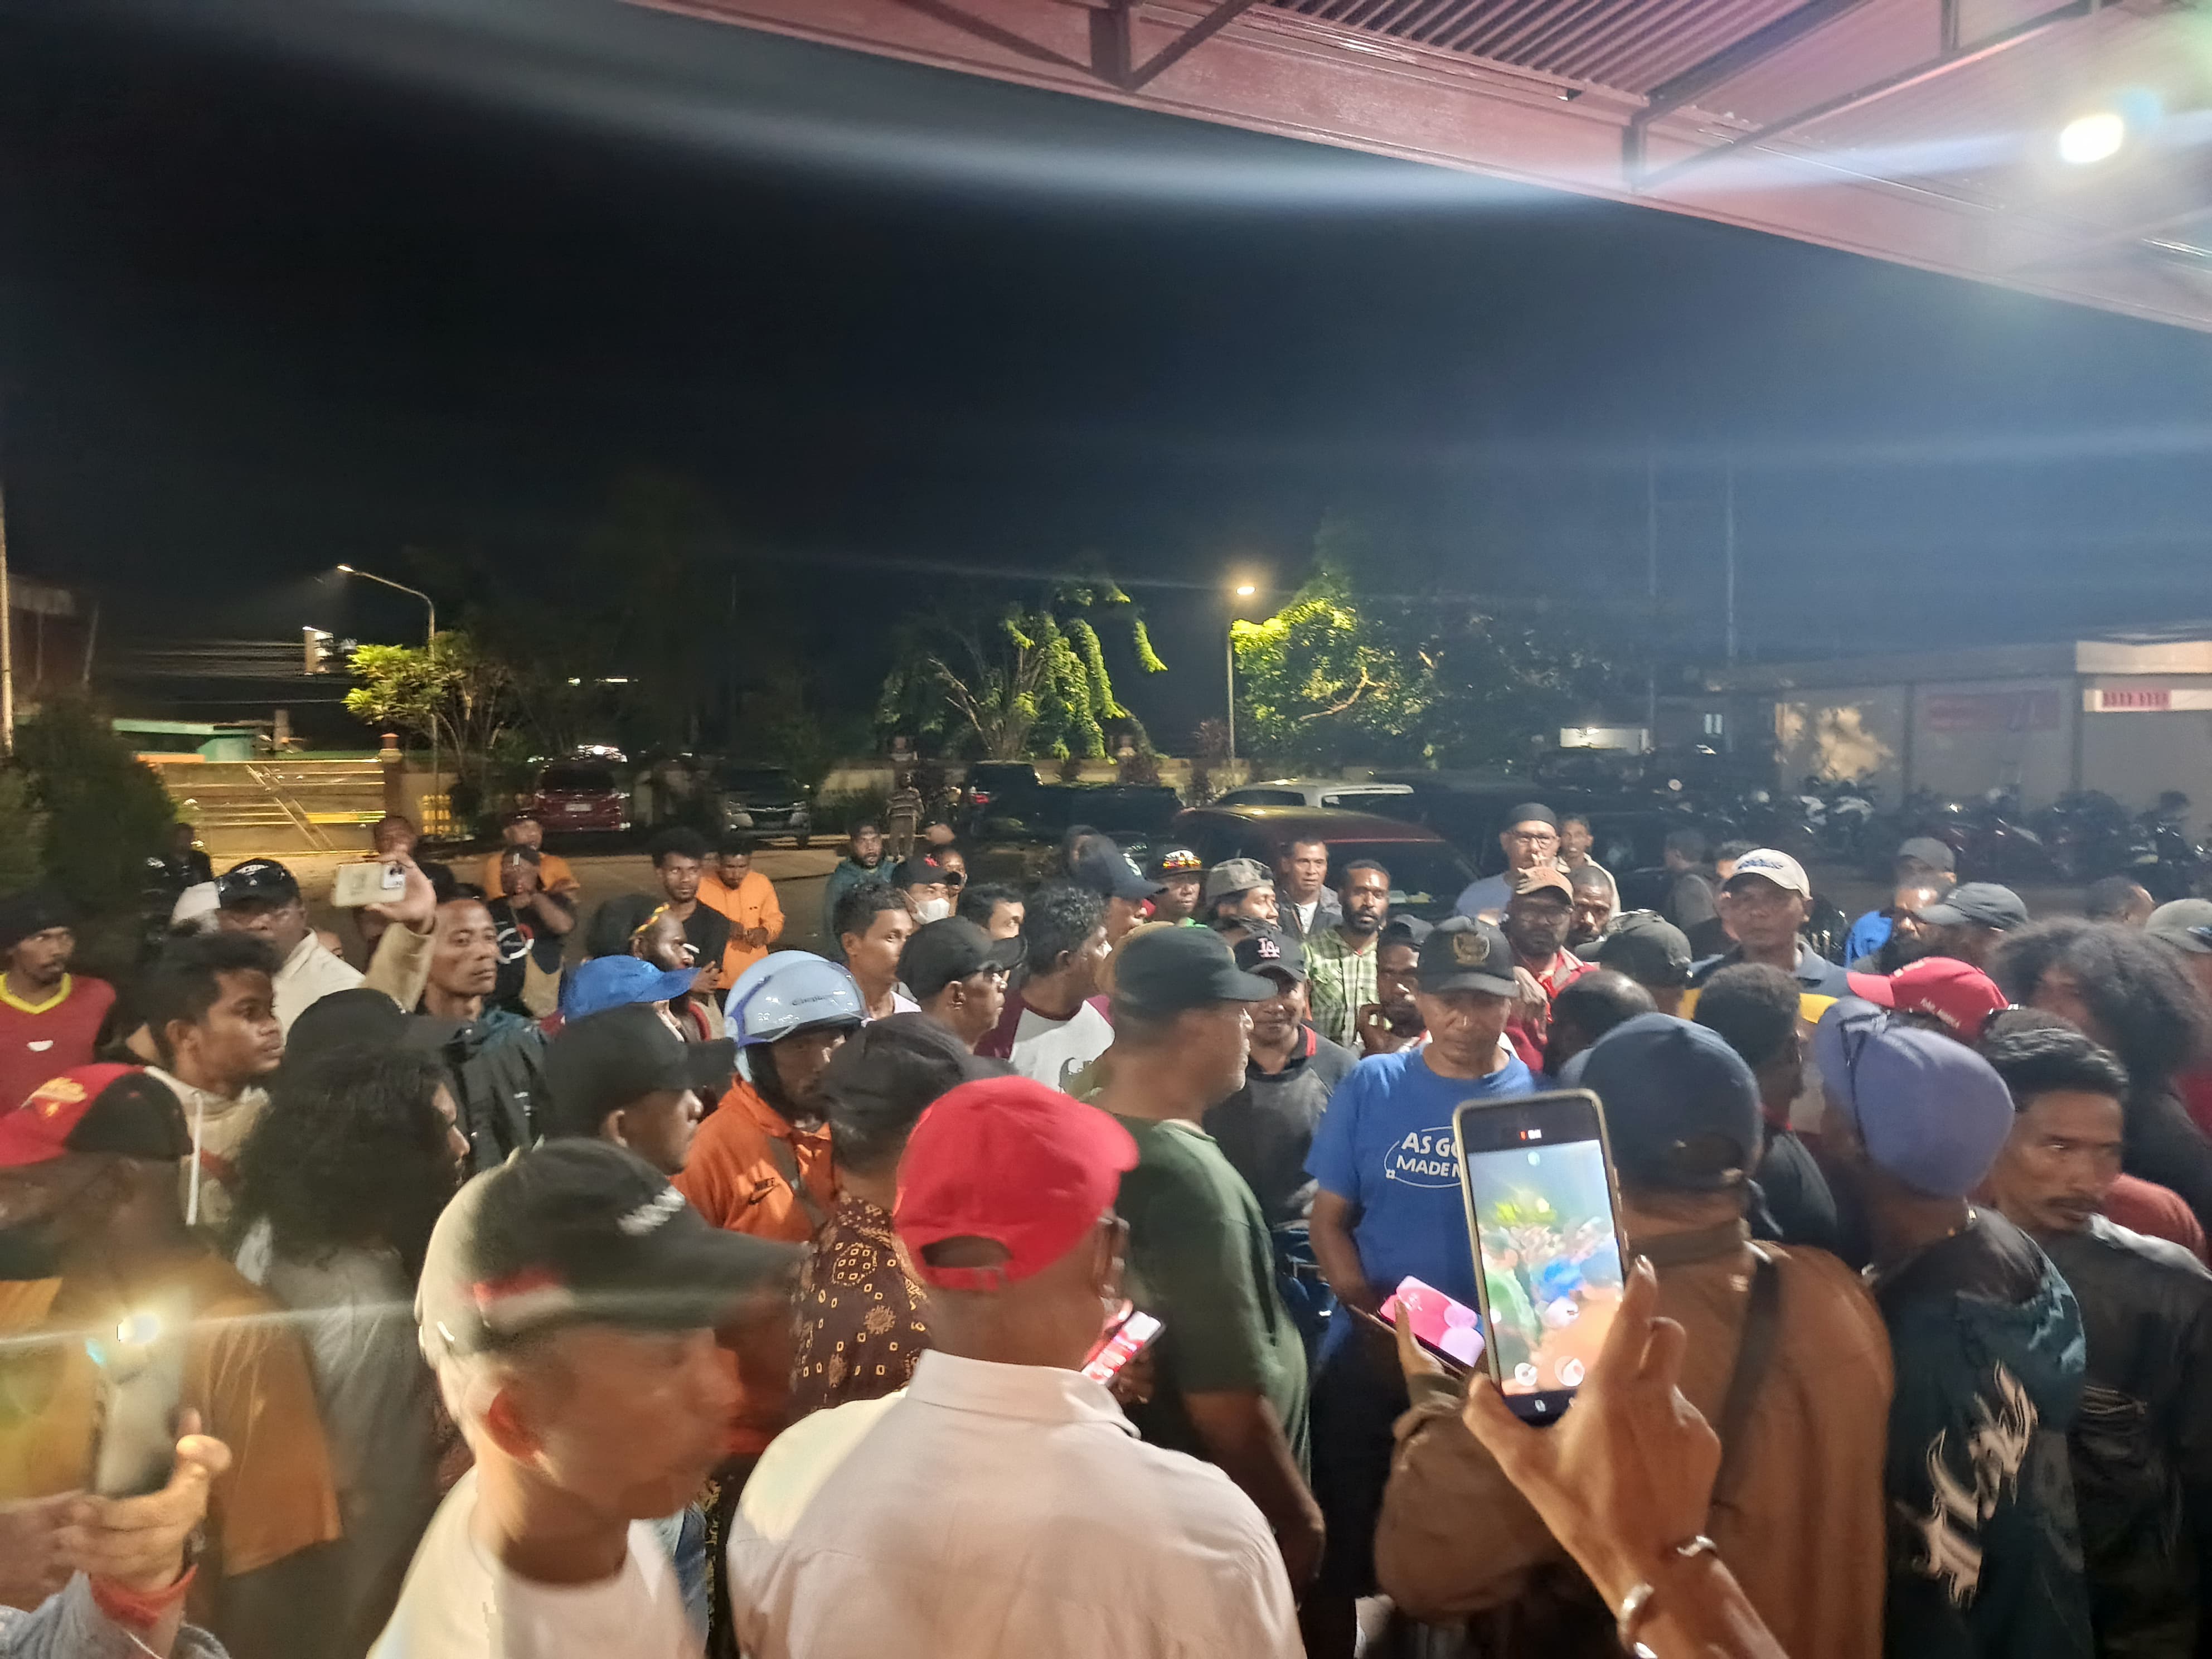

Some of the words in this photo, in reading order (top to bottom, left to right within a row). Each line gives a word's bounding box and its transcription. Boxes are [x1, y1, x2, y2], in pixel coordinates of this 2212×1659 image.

[1258, 938, 1280, 958] LA
[1401, 1132, 1432, 1154] AS
[1396, 1155, 1450, 1177] MADE
